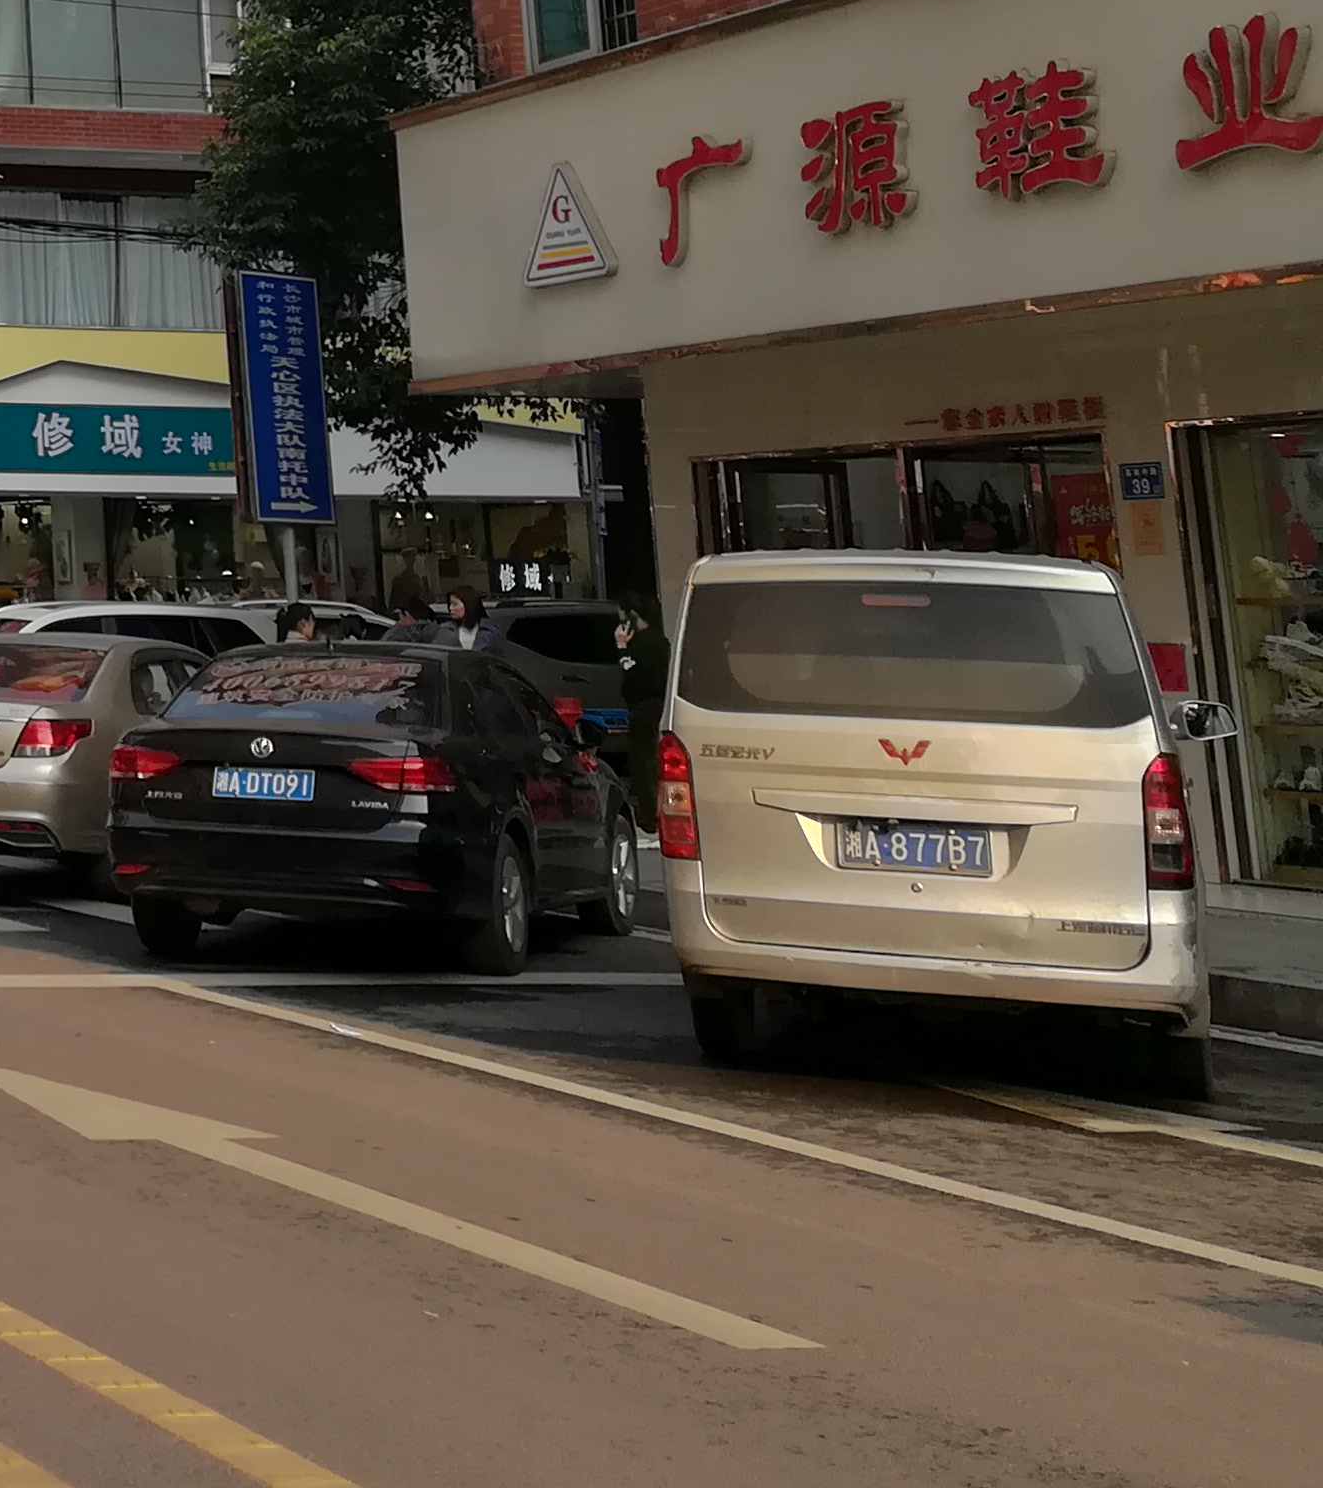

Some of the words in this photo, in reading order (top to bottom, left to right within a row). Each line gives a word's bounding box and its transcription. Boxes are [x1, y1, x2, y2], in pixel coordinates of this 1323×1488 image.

[655, 11, 1323, 269] 广源鞋业
[551, 195, 572, 224] G
[270, 355, 310, 501] 天心区执法大队南托中队
[1131, 478, 1151, 495] 39
[350, 799, 390, 810] LAVIDA
